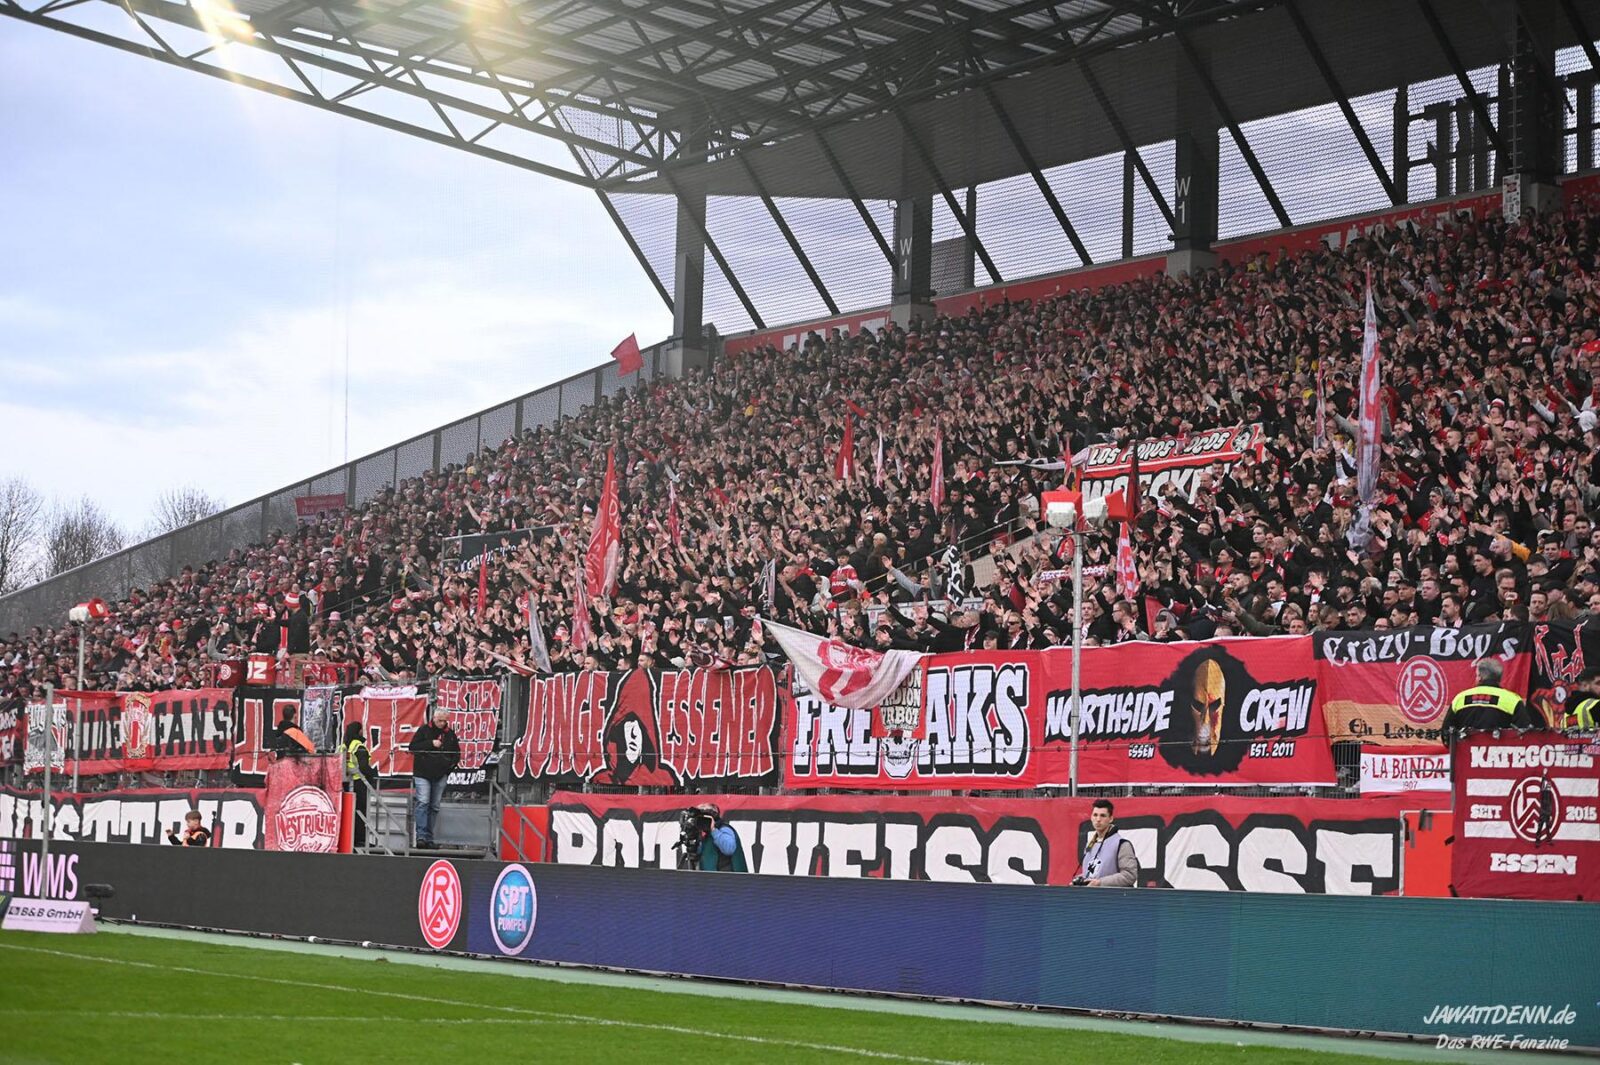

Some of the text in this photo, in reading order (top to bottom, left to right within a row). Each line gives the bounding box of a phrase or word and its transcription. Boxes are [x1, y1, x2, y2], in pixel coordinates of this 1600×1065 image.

[1182, 431, 1231, 455] OCOS
[437, 679, 501, 711] SEKTION
[513, 670, 611, 779] JUNGE
[659, 666, 777, 779] ESSENER
[1045, 686, 1313, 741] NORTHSIDE CREW
[153, 699, 230, 757] FANS
[1129, 742, 1295, 759] ESSEN EST. 2011
[1470, 744, 1594, 769] KATEGORIE
[1372, 756, 1446, 779] LA BANDA
[1469, 803, 1598, 821] SEIT 2015
[22, 851, 80, 900] WMS
[1489, 852, 1578, 876] ESSEN
[498, 884, 529, 917] SPT
[20, 907, 84, 920] B&B GmbH
[496, 916, 528, 933] PUMPEN
